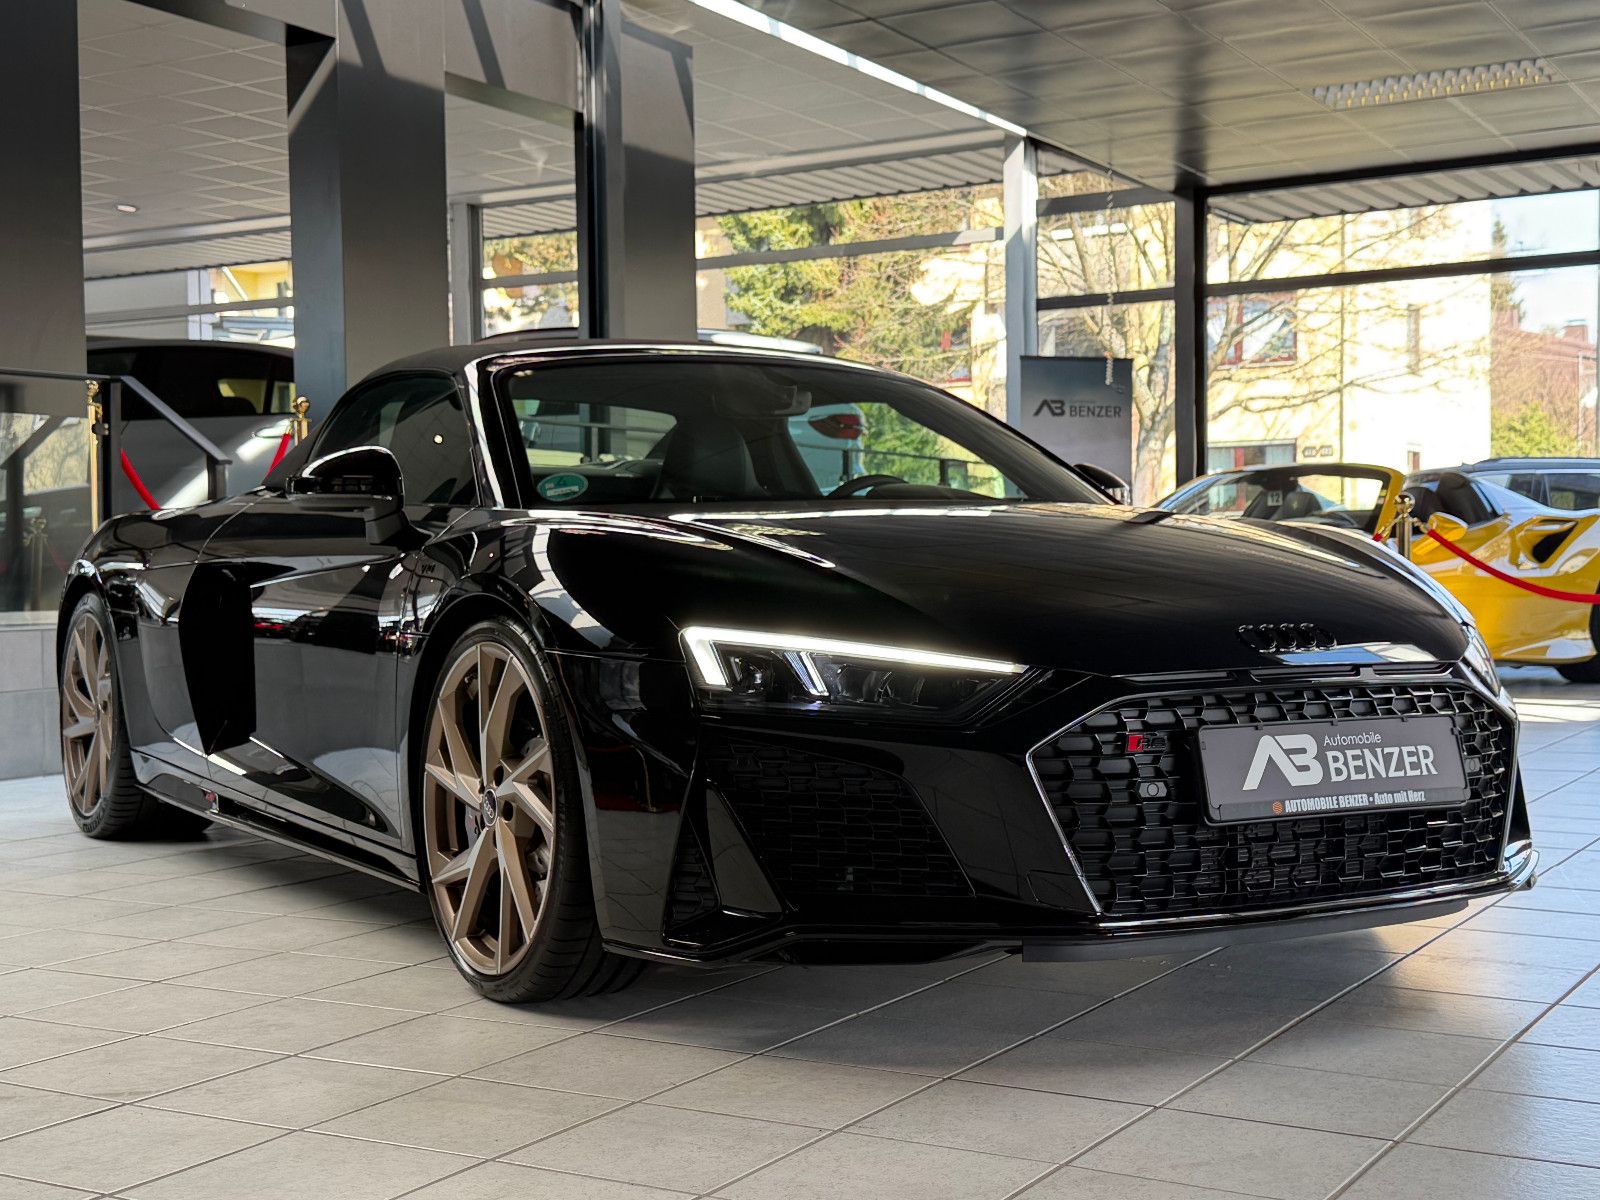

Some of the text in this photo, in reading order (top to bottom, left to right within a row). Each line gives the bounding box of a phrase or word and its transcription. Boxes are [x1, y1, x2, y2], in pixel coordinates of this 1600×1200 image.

[1069, 405, 1122, 418] BENZER
[1324, 732, 1382, 746] Automobile
[1325, 745, 1438, 783] BENZER
[1285, 788, 1426, 812] AUTOMOBILE BENZER Auto mit Herz
